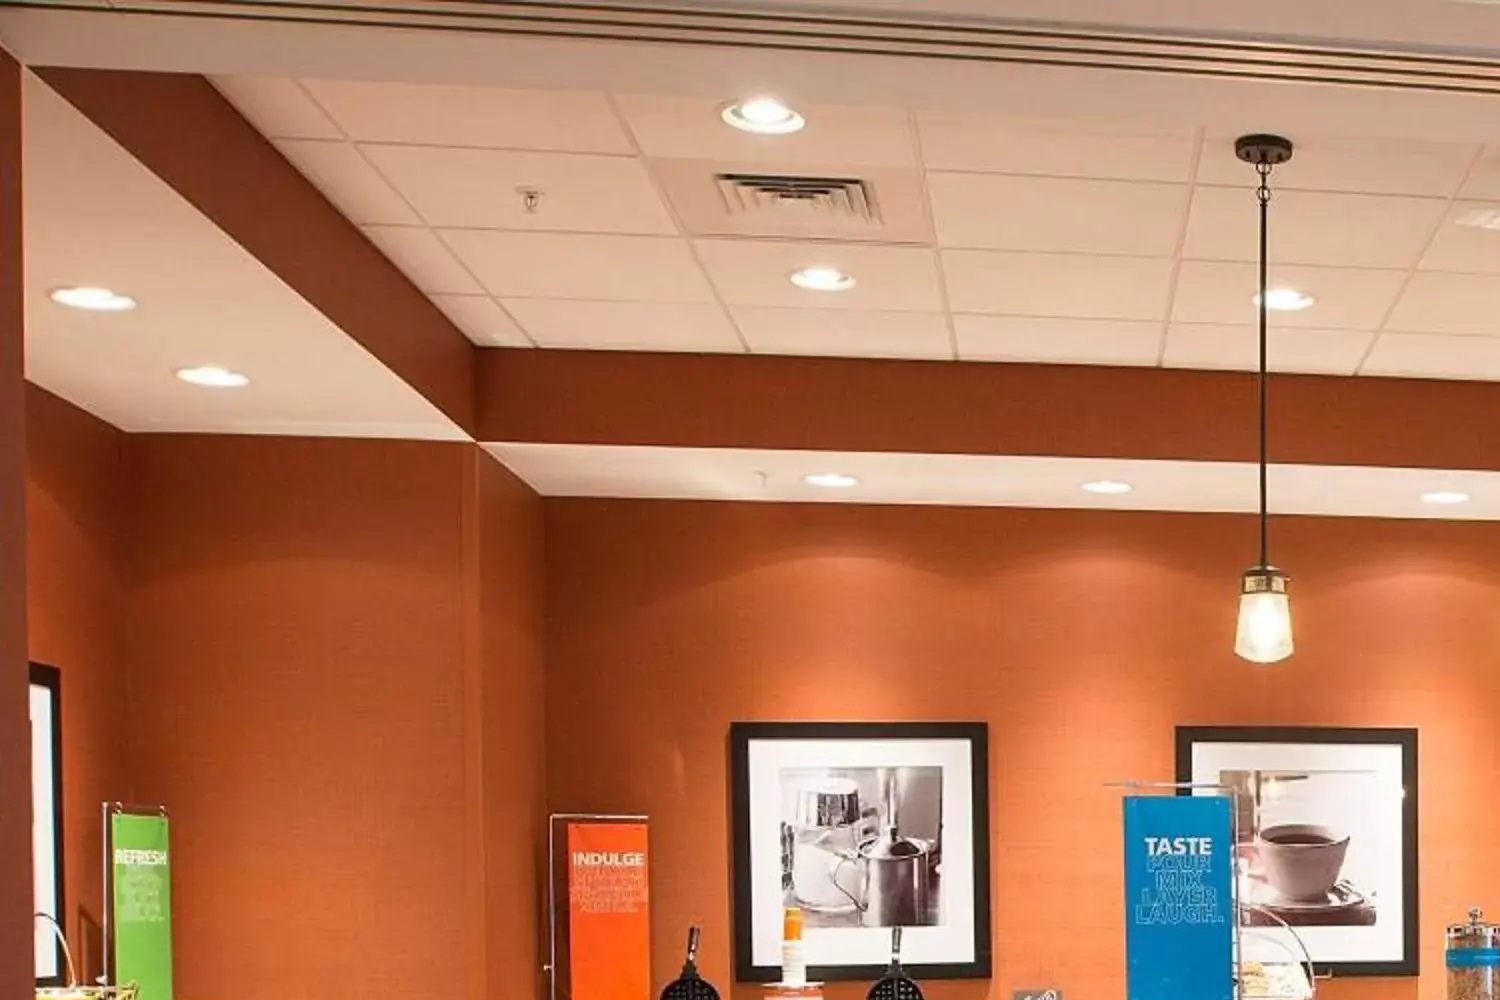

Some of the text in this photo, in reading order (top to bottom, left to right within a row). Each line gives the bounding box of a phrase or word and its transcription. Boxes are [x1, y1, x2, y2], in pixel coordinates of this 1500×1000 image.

[1144, 836, 1213, 855] TASTE
[115, 848, 167, 865] REFRESH
[573, 851, 645, 866] INDULGE
[1146, 854, 1212, 873] POUR
[1155, 870, 1203, 889] MIX
[1141, 887, 1217, 906] LAYER
[1135, 904, 1225, 925] LAUGH.
